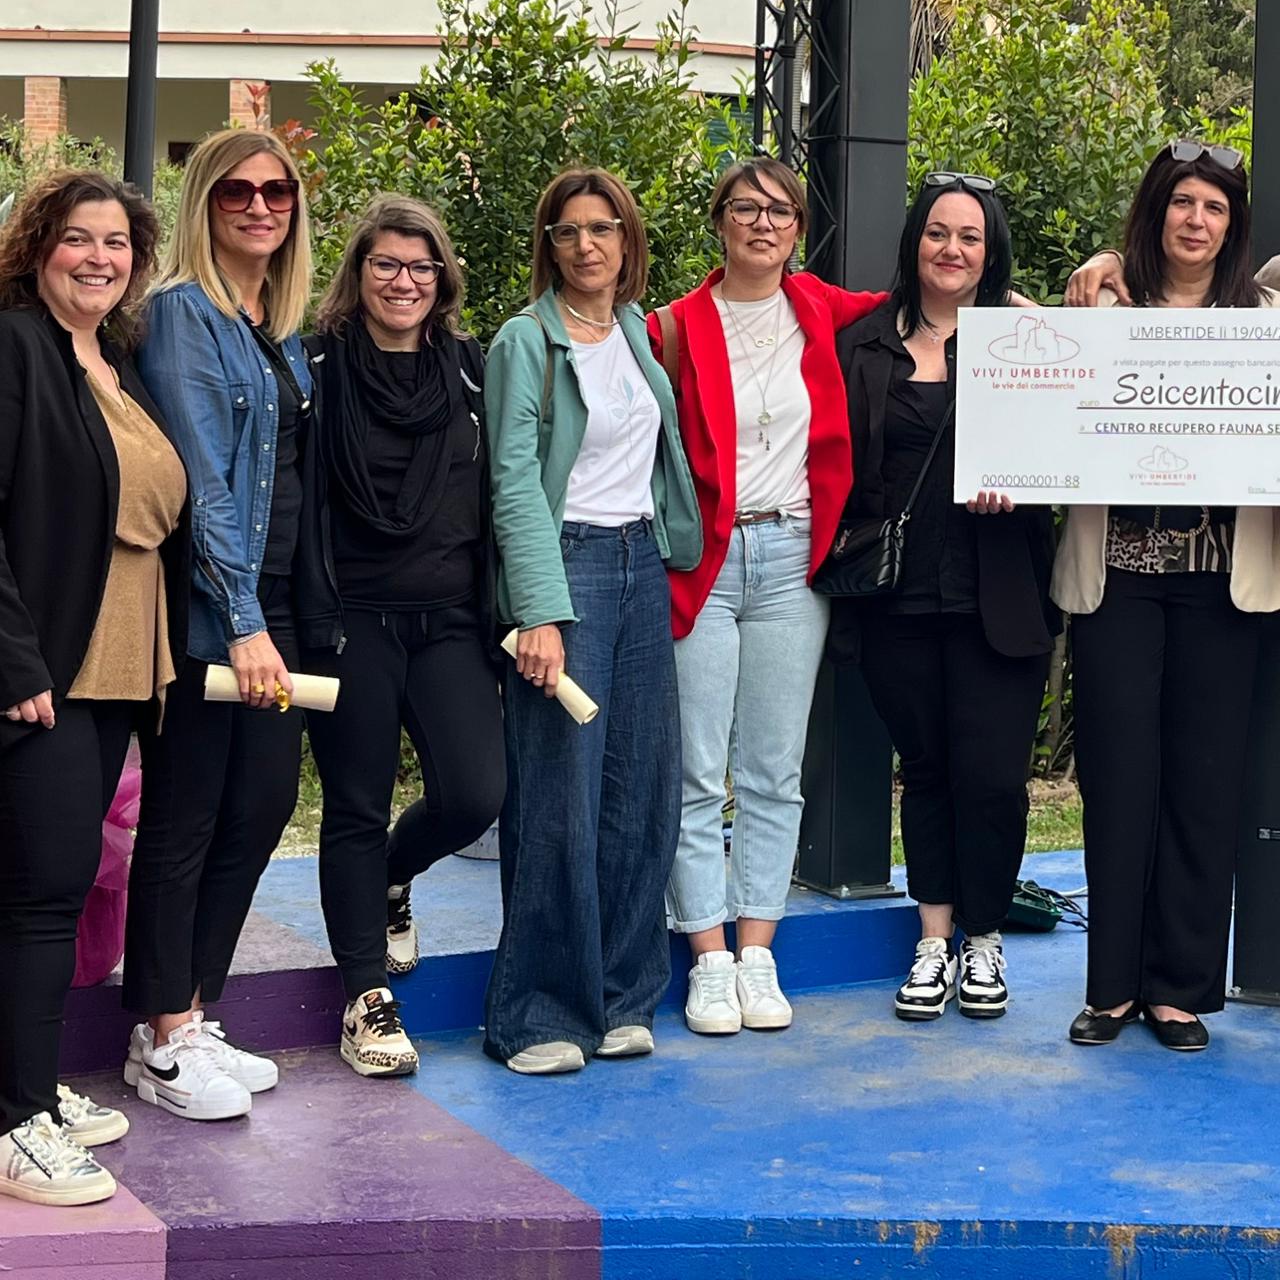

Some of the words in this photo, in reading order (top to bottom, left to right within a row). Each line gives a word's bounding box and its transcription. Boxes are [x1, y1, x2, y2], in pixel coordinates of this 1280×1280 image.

[1129, 326, 1217, 339] UMBERTIDE
[1140, 359, 1166, 368] pagate
[1168, 360, 1182, 368] per
[1184, 359, 1211, 368] questo
[1212, 359, 1245, 368] assegno
[972, 368, 1003, 378] VIVI
[1010, 368, 1096, 378] UMBERTIDE
[992, 382, 1000, 390] le
[1030, 382, 1075, 390] commercio
[1095, 423, 1145, 433] CENTRO
[1150, 423, 1215, 434] RECUPERO
[1219, 423, 1263, 434] FAUNA
[981, 474, 1080, 486] 0000000001-88
